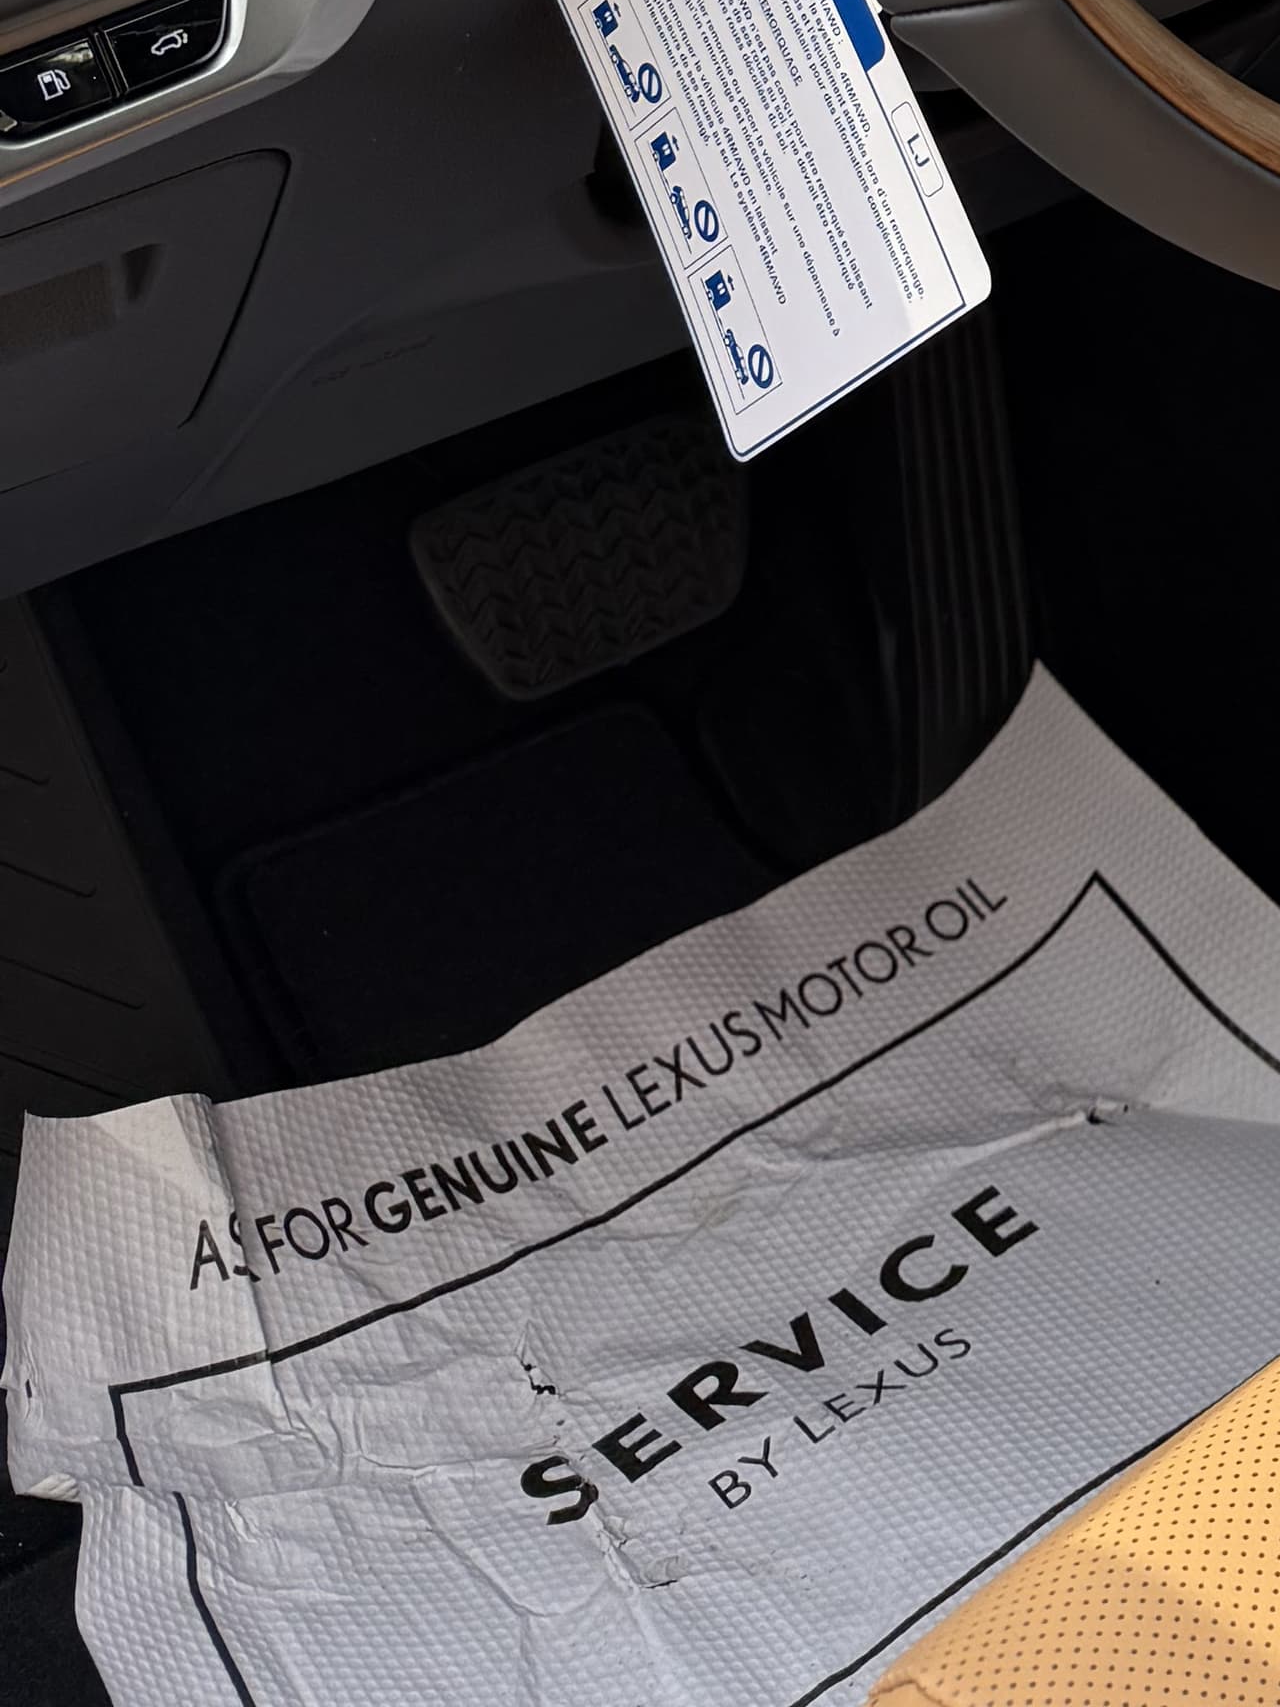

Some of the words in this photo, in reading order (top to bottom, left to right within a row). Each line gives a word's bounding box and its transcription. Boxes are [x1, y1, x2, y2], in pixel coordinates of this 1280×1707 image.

[254, 1197, 369, 1274] FOR
[364, 1099, 609, 1234] GENUINE
[602, 1011, 762, 1130] LEXUS
[753, 923, 935, 1041] MOTOR
[925, 878, 1008, 942] OIL
[520, 1185, 1040, 1526] SERVICE
[707, 1435, 778, 1510] BY
[794, 1327, 972, 1445] LEXUS
